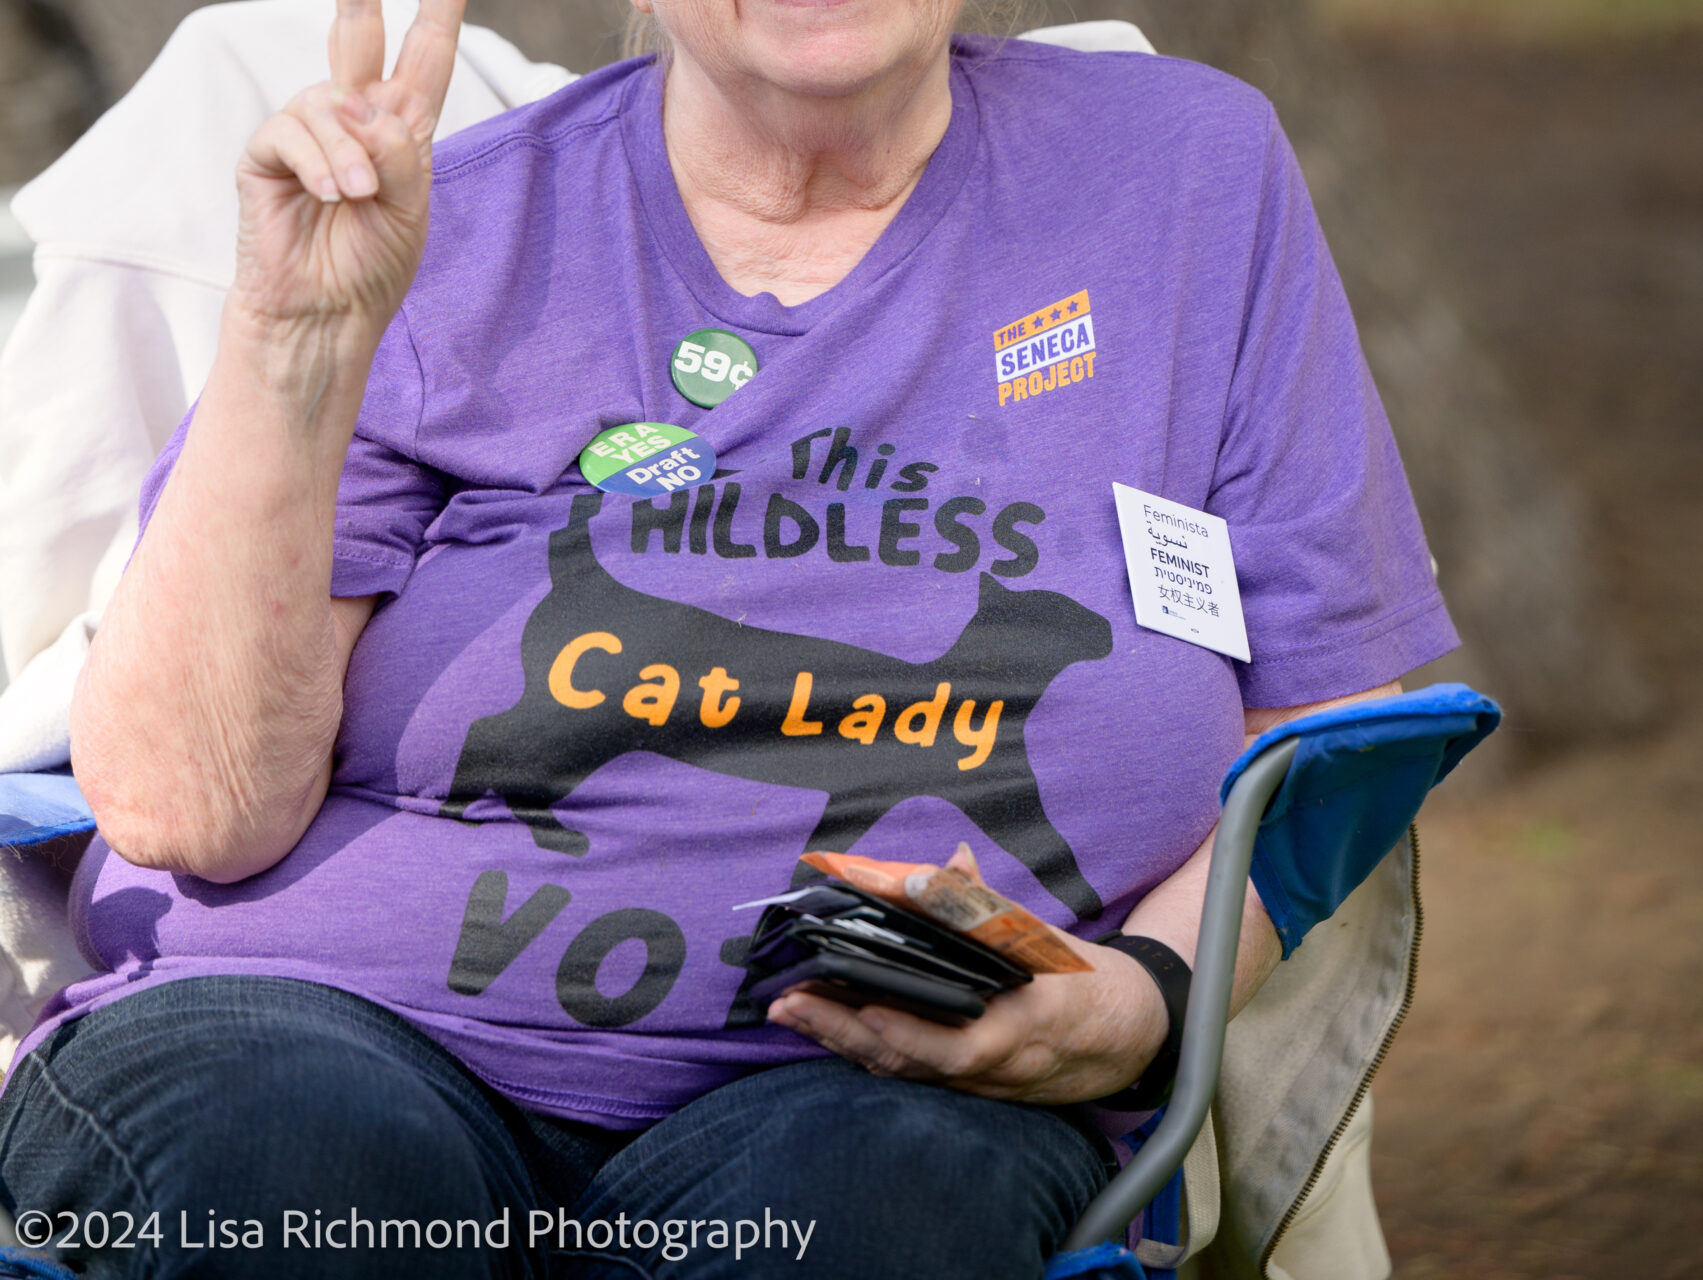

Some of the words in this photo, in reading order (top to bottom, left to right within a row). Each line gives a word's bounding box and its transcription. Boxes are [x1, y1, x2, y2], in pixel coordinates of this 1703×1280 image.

[997, 322, 1027, 346] THE
[1001, 322, 1090, 376] SENECA
[674, 340, 754, 391] 59¢
[997, 351, 1097, 407] PROJECT
[587, 424, 660, 458] ERA
[609, 434, 673, 464] YES
[790, 426, 940, 493] This
[625, 446, 701, 486] Draft
[655, 465, 702, 492] NO
[629, 481, 1047, 579] HILDLESS
[1143, 504, 1209, 538] Feminista
[1150, 547, 1210, 579] FEMINIST
[1157, 584, 1220, 618] 女权主义者
[548, 631, 742, 729] Cat
[780, 671, 1005, 771] Lady
